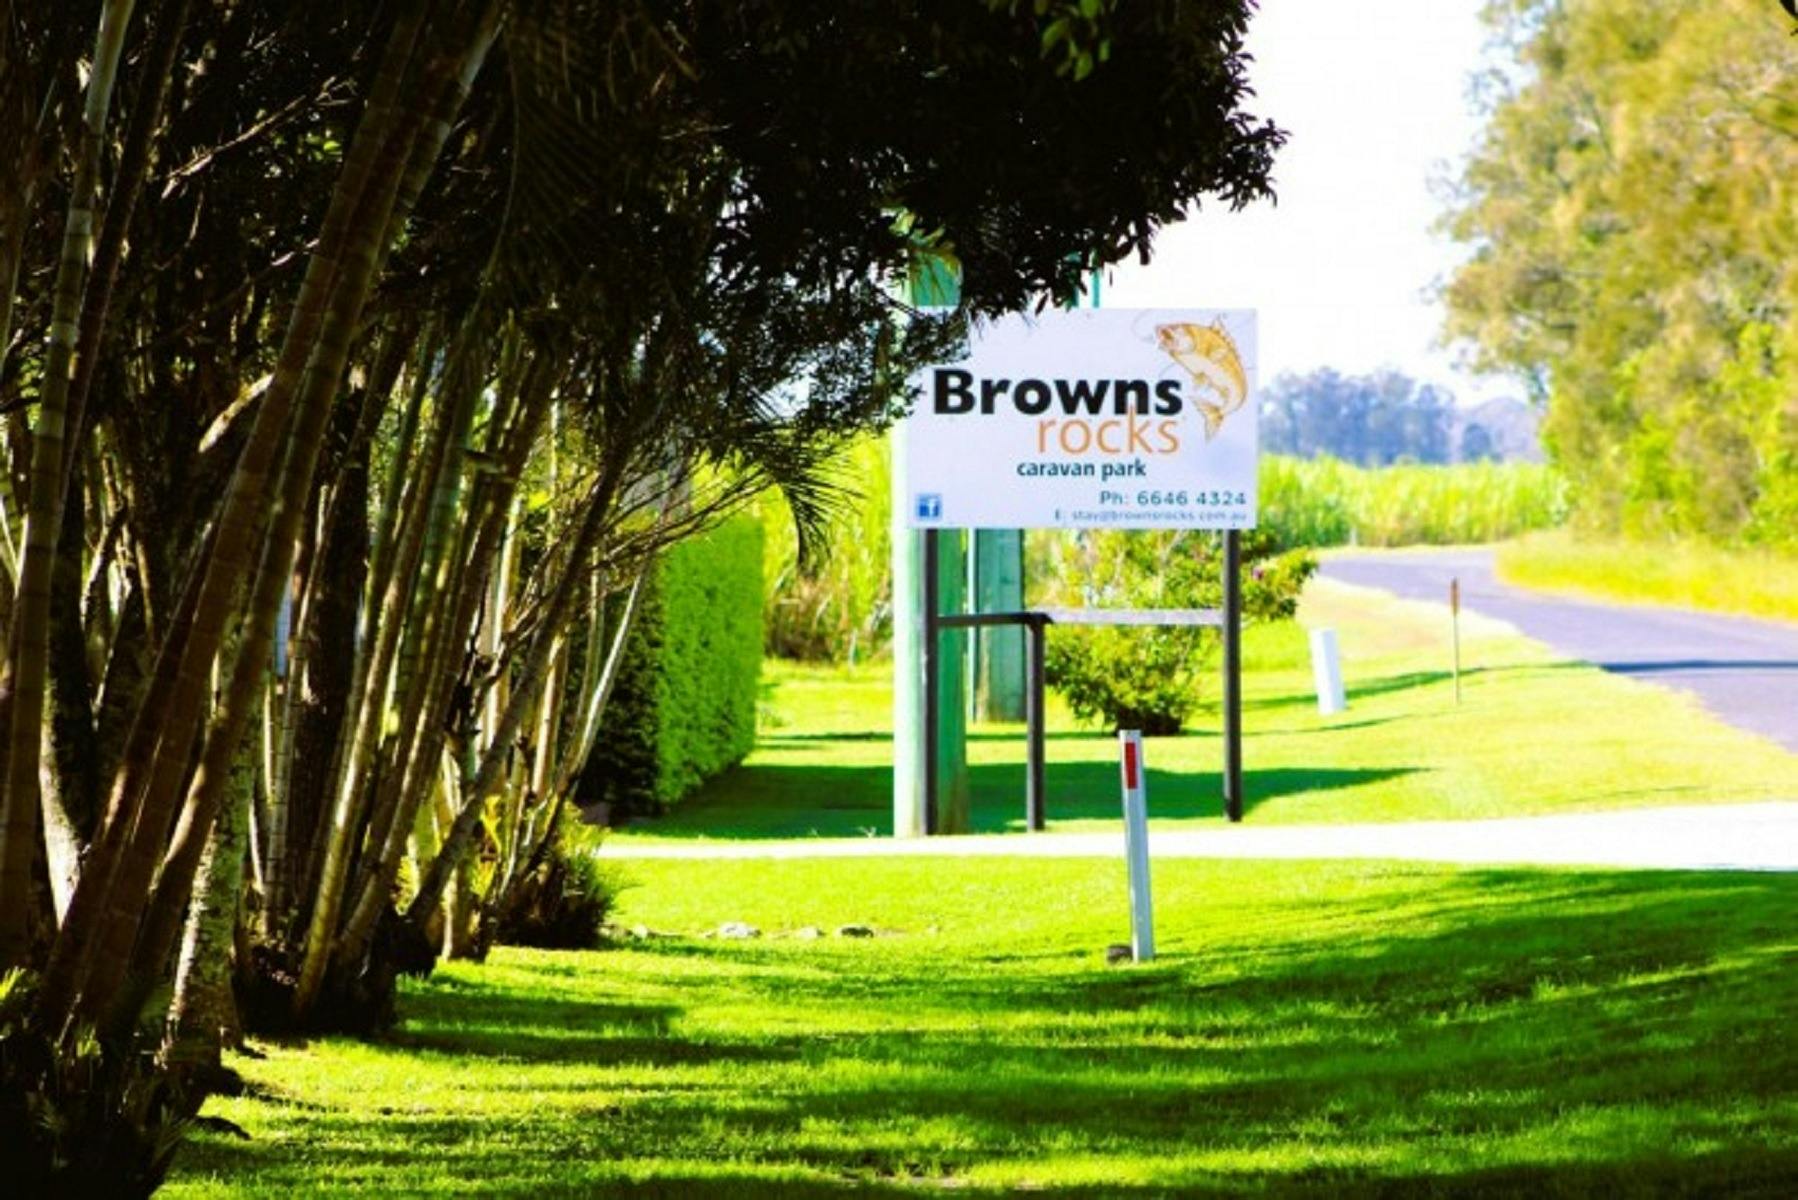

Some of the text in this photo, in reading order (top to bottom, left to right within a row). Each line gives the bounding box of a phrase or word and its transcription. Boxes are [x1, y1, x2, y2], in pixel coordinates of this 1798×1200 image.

[933, 368, 1183, 415] Browns
[1038, 402, 1180, 455] rocks
[1016, 457, 1146, 481] caravan park
[1100, 490, 1247, 506] Ph: 6646 4324
